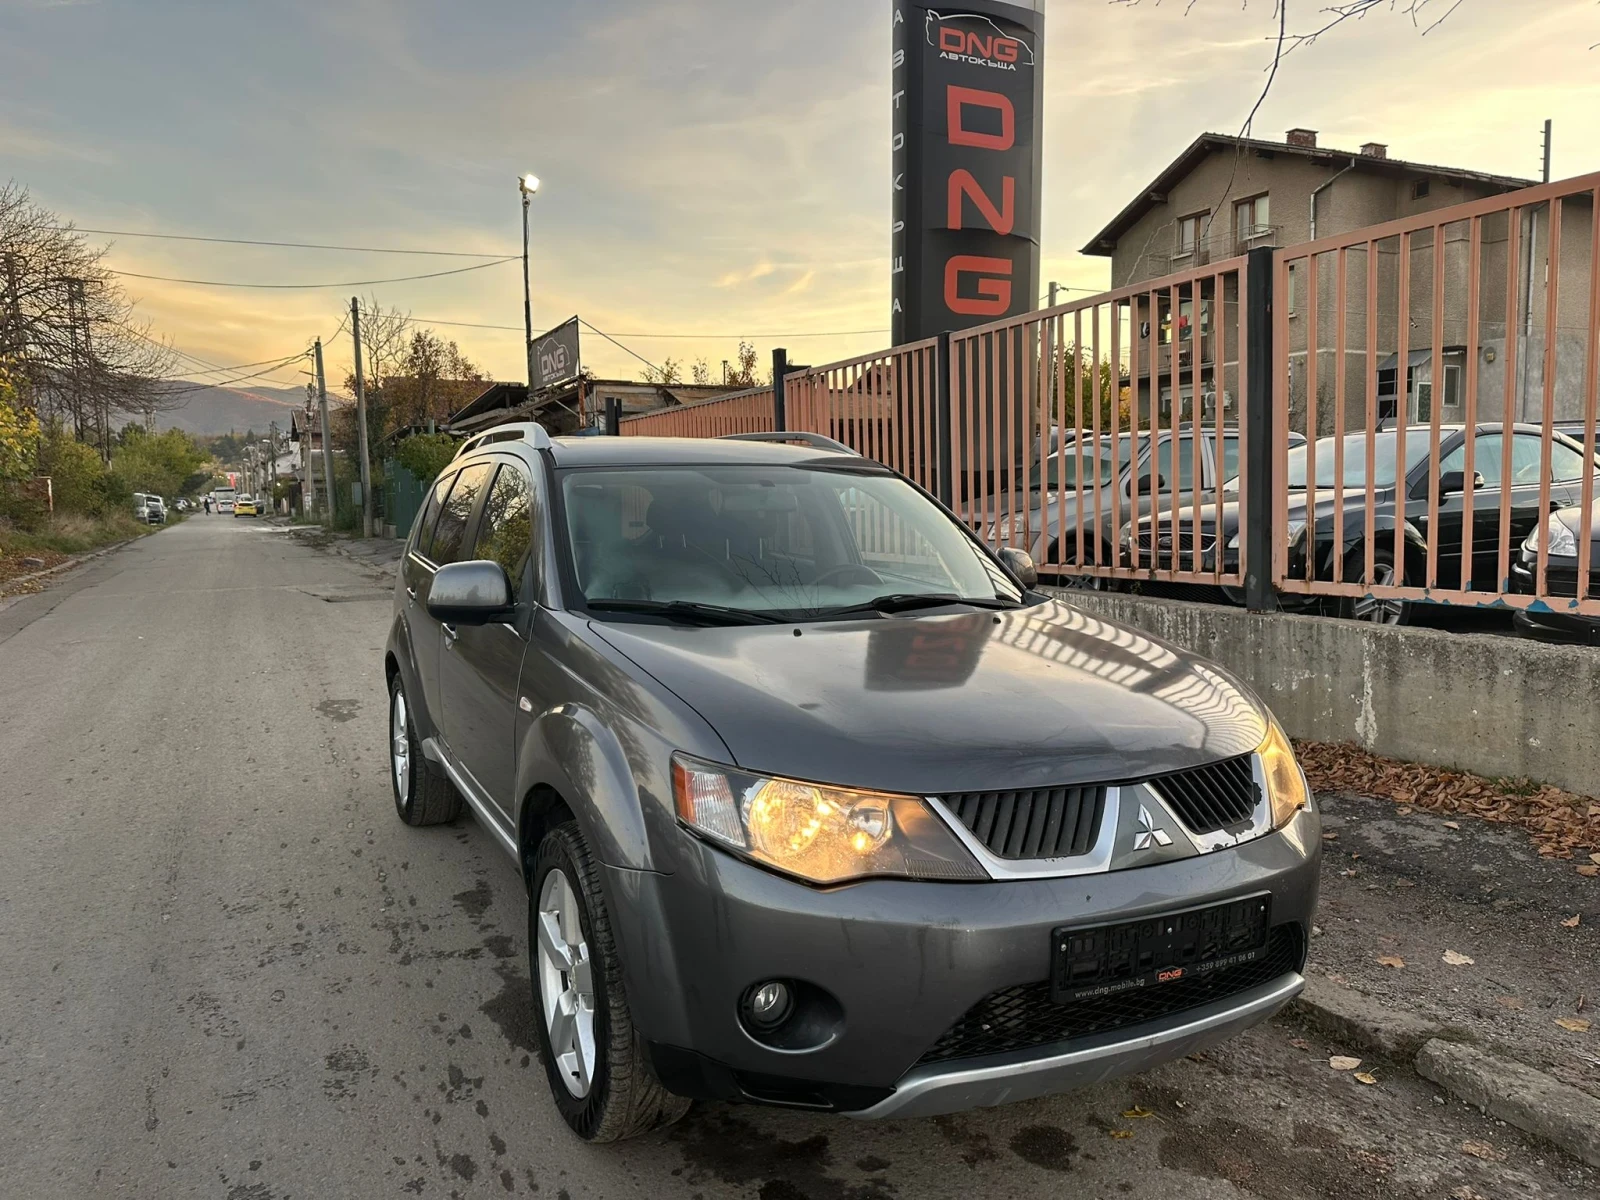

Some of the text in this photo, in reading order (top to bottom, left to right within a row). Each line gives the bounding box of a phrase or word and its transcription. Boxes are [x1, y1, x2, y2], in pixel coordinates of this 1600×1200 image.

[940, 27, 1018, 63] DNG
[939, 51, 1017, 71] АВТОКЪЩА
[944, 85, 1015, 316] DNG
[541, 347, 564, 375] DNG
[1196, 961, 1214, 972] +359
[1247, 951, 1255, 960] 01
[1158, 968, 1183, 980] DNG
[1074, 977, 1145, 998] www.dng.mobile.bg
